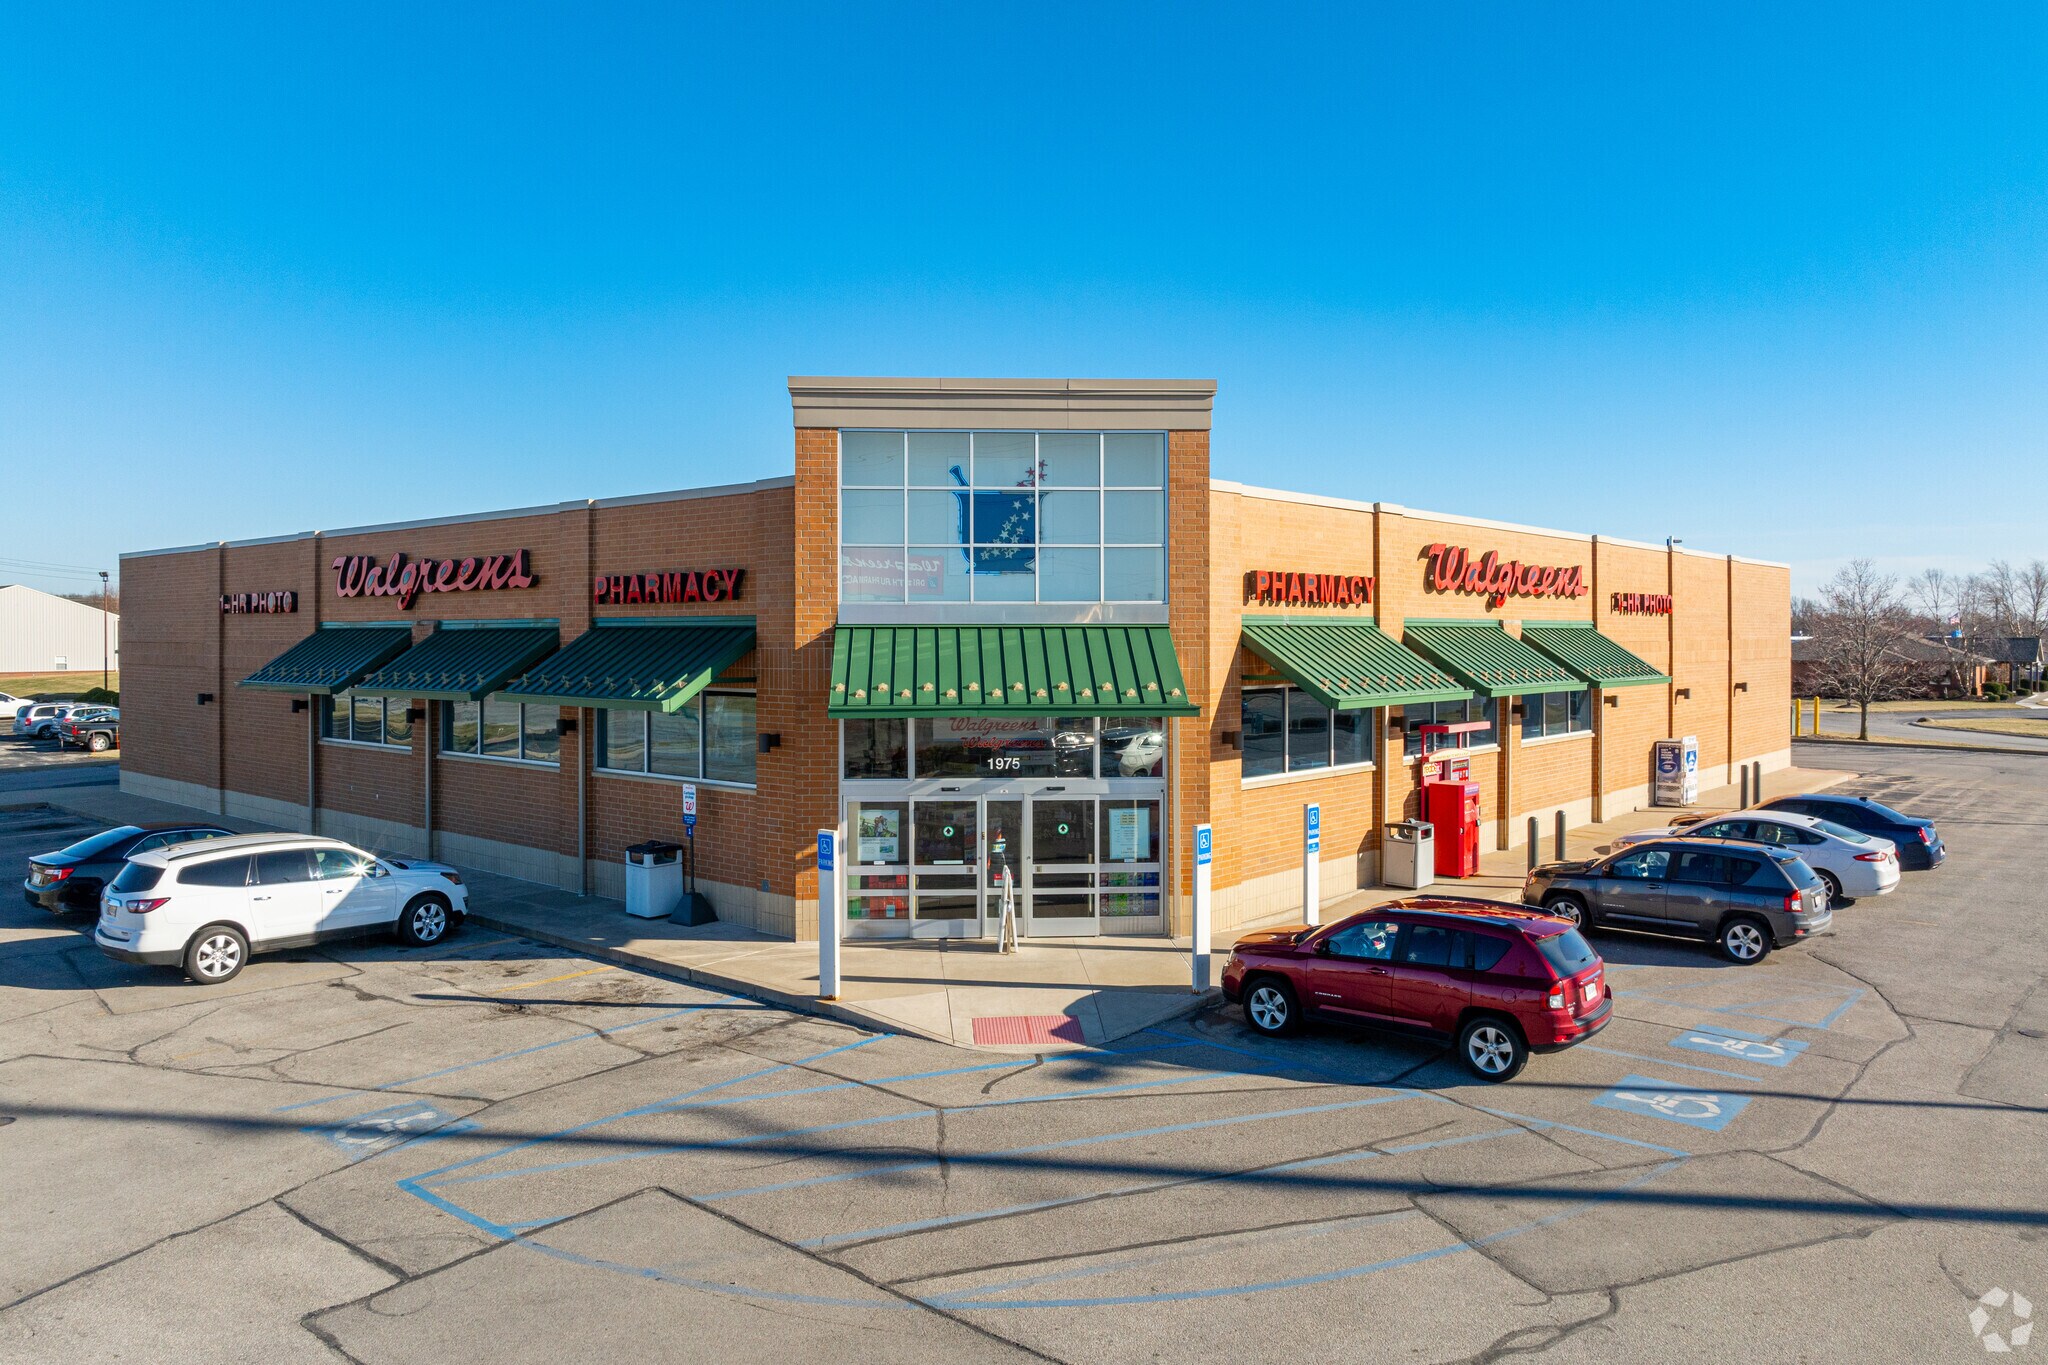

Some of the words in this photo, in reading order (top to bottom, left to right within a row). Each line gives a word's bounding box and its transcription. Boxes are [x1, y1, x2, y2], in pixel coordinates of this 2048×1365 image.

[332, 548, 535, 610] Walgreens
[594, 568, 740, 605] PHARMACY
[1256, 570, 1376, 604] PHARMACY
[1428, 543, 1589, 608] Walgreens
[219, 593, 247, 614] 1-HR
[251, 591, 293, 614] PHOTO
[1616, 593, 1640, 613] 1-HR
[1643, 594, 1673, 615] PHOTO
[949, 717, 1039, 736] Walgreens
[987, 757, 1021, 770] 1975
